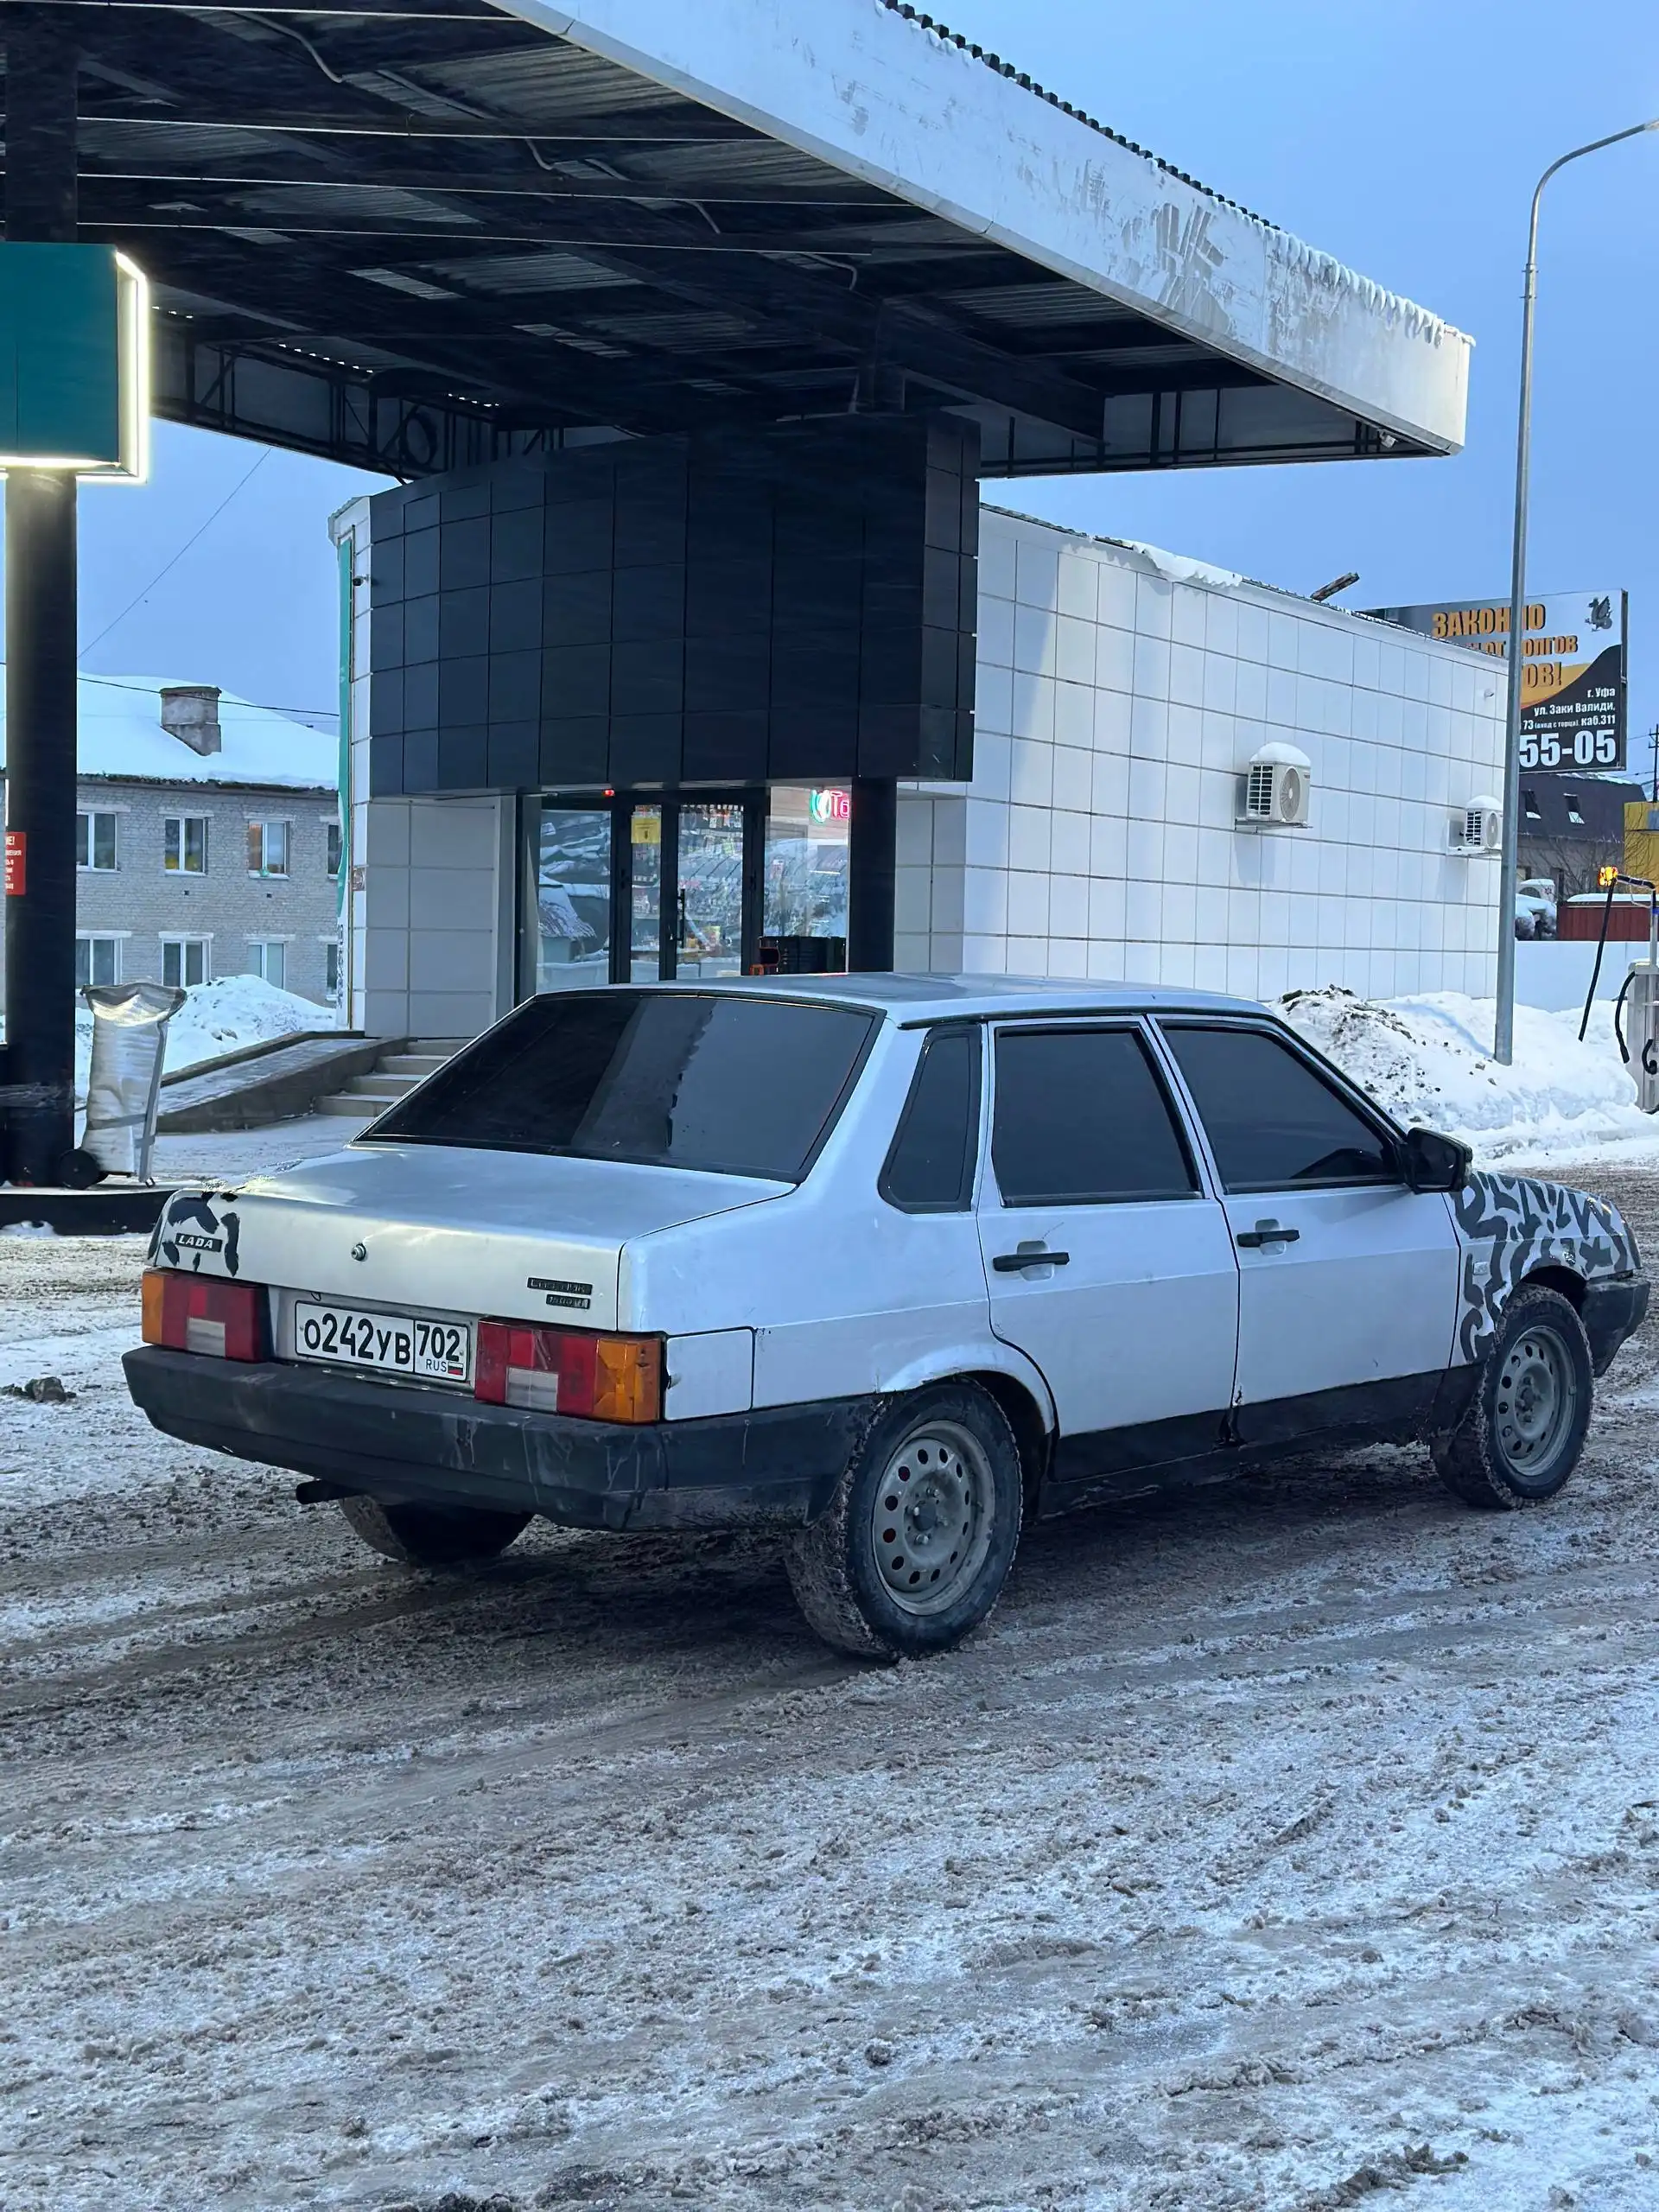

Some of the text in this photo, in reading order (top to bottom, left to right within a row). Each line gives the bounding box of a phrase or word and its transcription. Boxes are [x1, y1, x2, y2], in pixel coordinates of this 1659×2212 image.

[1522, 635, 1578, 657] ОЛГОВ
[1522, 661, 1562, 688] ОВ!
[1587, 687, 1616, 698] г. Уфа
[1534, 706, 1548, 716] ул.
[1549, 704, 1573, 715] Заки
[1522, 720, 1534, 730] 73
[1580, 715, 1616, 726] каб.311
[1519, 728, 1616, 767] 55-05
[178, 1235, 213, 1249] LADA
[304, 1313, 460, 1365] О242УВ 702
[425, 1358, 448, 1373] RUS
